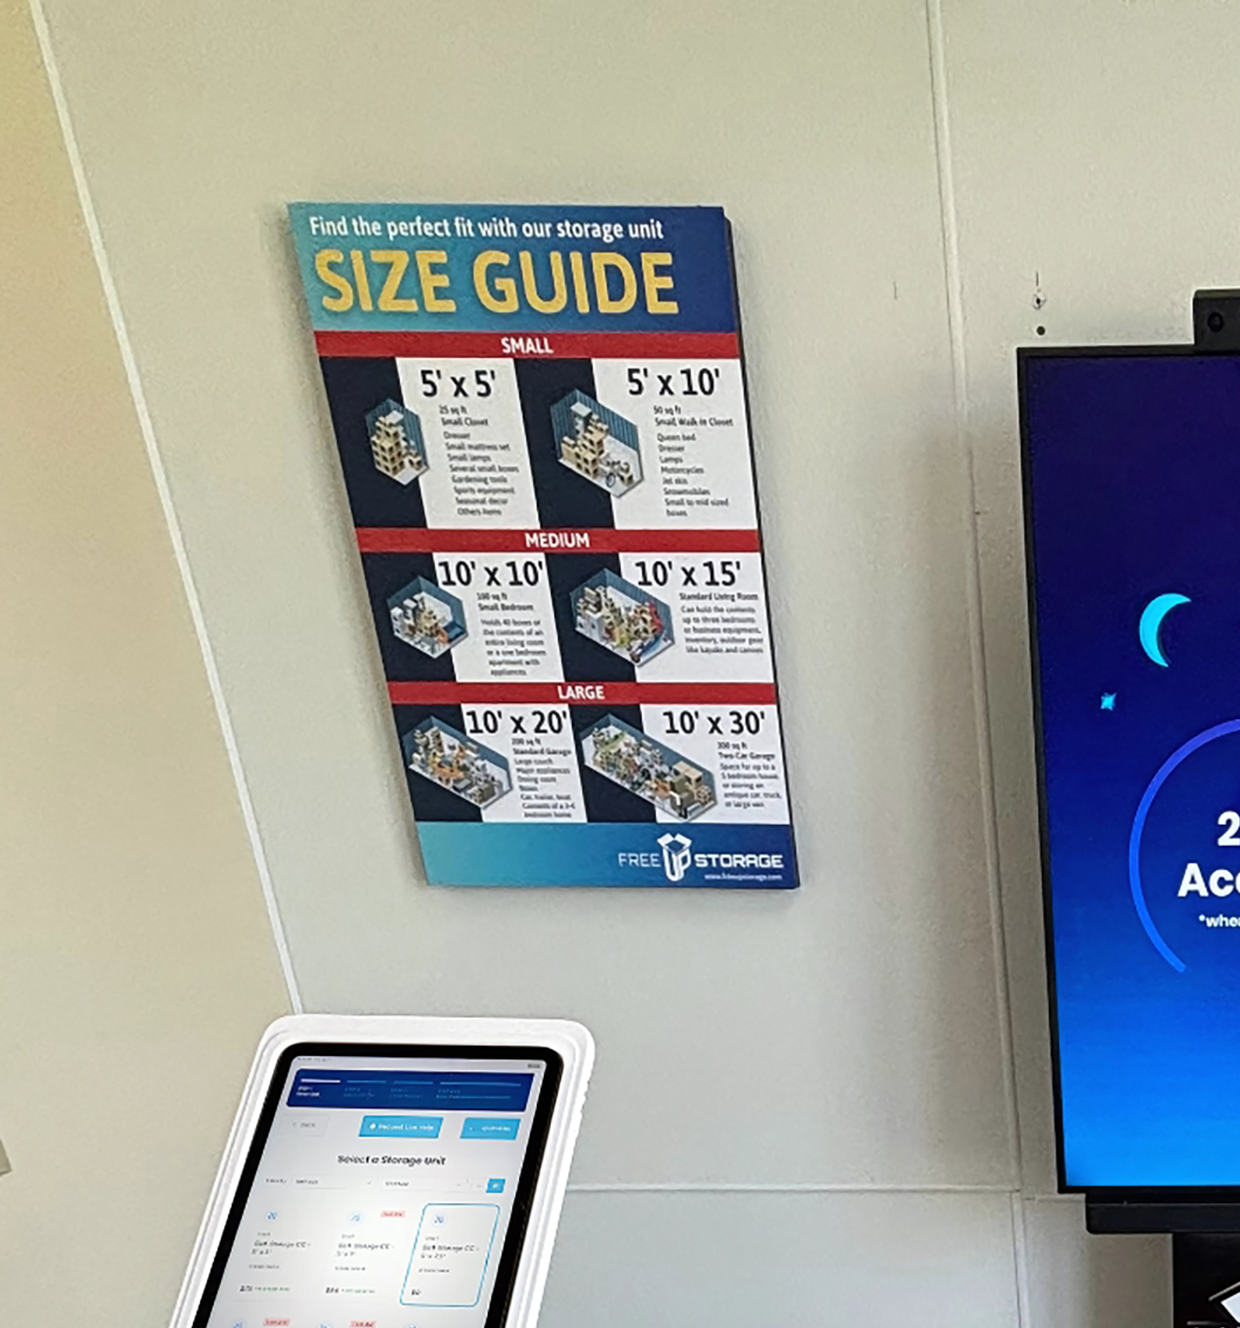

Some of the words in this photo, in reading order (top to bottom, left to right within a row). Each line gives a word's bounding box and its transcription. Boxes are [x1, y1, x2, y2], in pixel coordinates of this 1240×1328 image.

[310, 216, 348, 237] Find
[353, 216, 382, 237] the
[387, 217, 450, 241] perfect
[455, 218, 475, 237] fit
[477, 218, 518, 238] with
[521, 223, 552, 239] our
[557, 219, 623, 243] storage
[628, 220, 664, 240] unit
[314, 249, 457, 313] SIZE
[472, 250, 680, 315] GUIDE
[501, 337, 554, 355] SMALL
[420, 369, 442, 397] 5'
[450, 376, 469, 397] x
[475, 369, 496, 397] 5'
[627, 368, 648, 396] 5'
[657, 375, 674, 396] x
[680, 368, 720, 396] 10'
[525, 532, 590, 549] MEDIUM
[438, 561, 475, 586] 10'
[484, 567, 501, 586] x
[506, 561, 543, 586] 10'
[635, 560, 673, 586] 10'
[681, 567, 698, 586] x
[703, 560, 741, 586] 15'
[557, 686, 605, 700] LARGE
[466, 710, 502, 734] 10'
[510, 716, 527, 734] x
[531, 710, 567, 734] 20'
[663, 711, 699, 734] 10'
[707, 716, 723, 735] x
[729, 711, 765, 735] 30'
[618, 852, 661, 867] FREE
[694, 854, 784, 868] STORAGE
